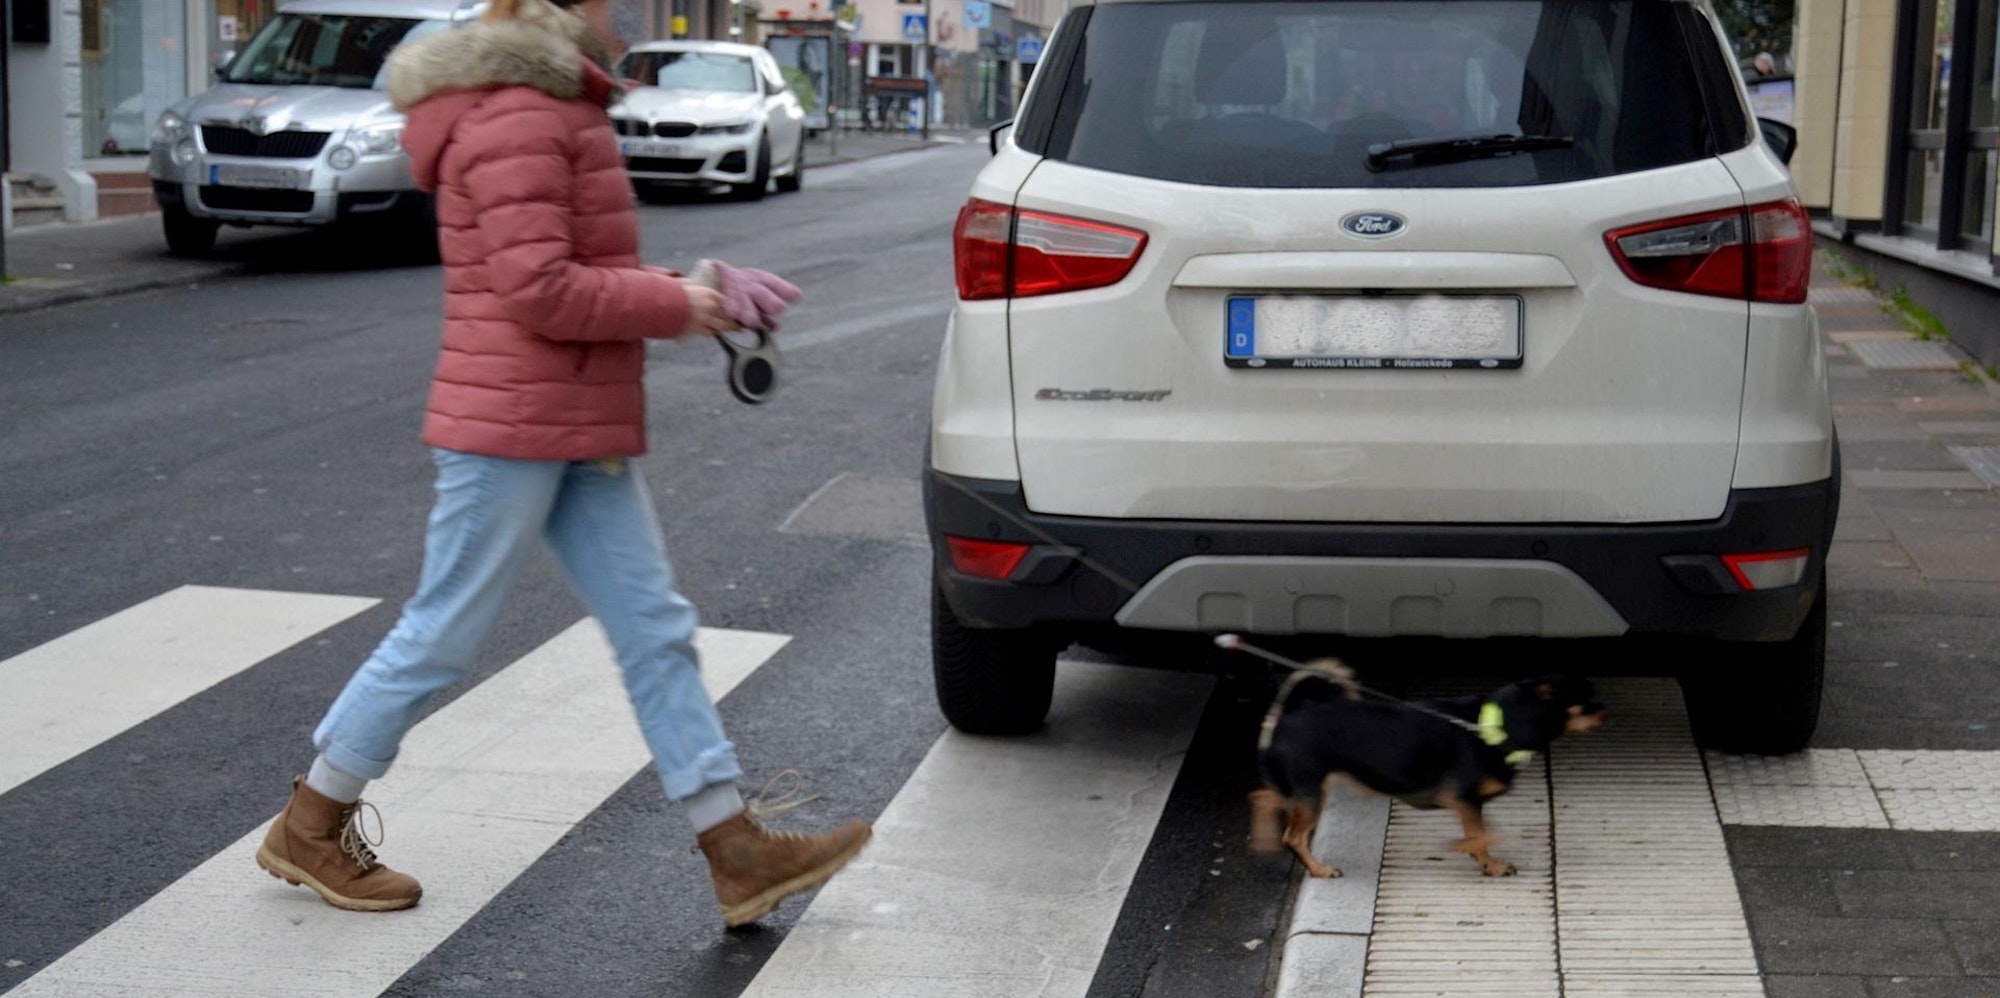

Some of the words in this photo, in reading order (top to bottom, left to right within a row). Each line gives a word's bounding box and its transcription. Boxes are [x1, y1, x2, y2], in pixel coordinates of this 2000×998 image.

[1355, 215, 1392, 232] Ford
[1236, 333, 1247, 347] D
[1293, 358, 1345, 367] AUTOHAUS
[1347, 358, 1381, 367] KLEINE
